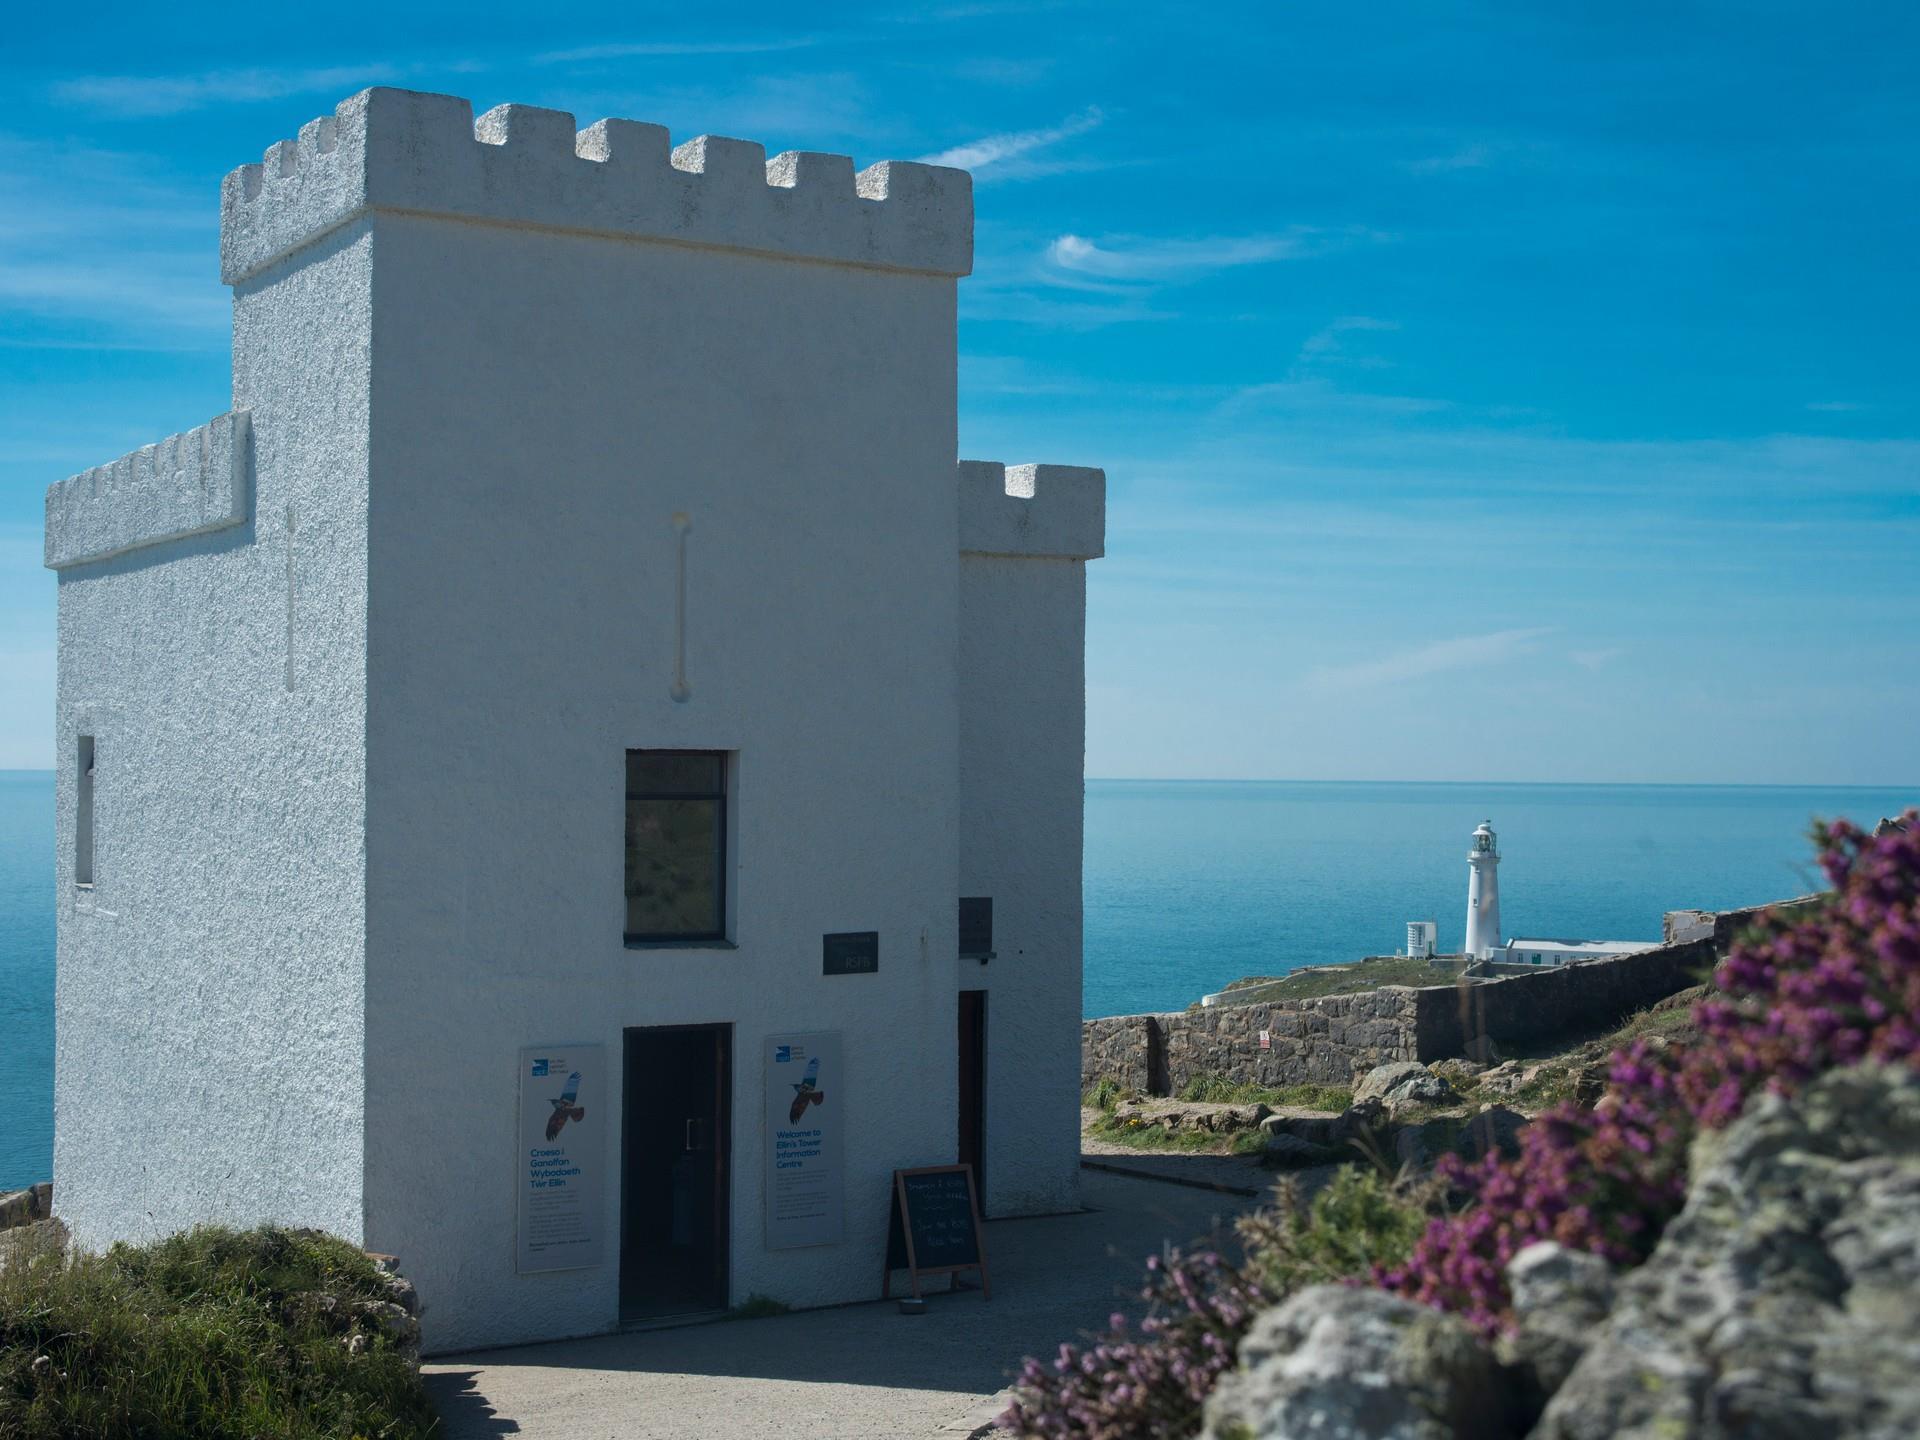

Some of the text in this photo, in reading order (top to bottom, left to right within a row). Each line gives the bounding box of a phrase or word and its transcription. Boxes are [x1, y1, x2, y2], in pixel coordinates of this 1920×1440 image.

[776, 1130, 811, 1139] Welcome
[776, 1139, 821, 1149] Ellin's Tower
[530, 1149, 560, 1157] Croeso
[776, 1149, 821, 1159] Information
[530, 1157, 570, 1168] Ganolfan
[776, 1160, 803, 1169] Centre
[530, 1167, 581, 1179] Wybodaeth
[549, 1178, 566, 1187] Ellin
